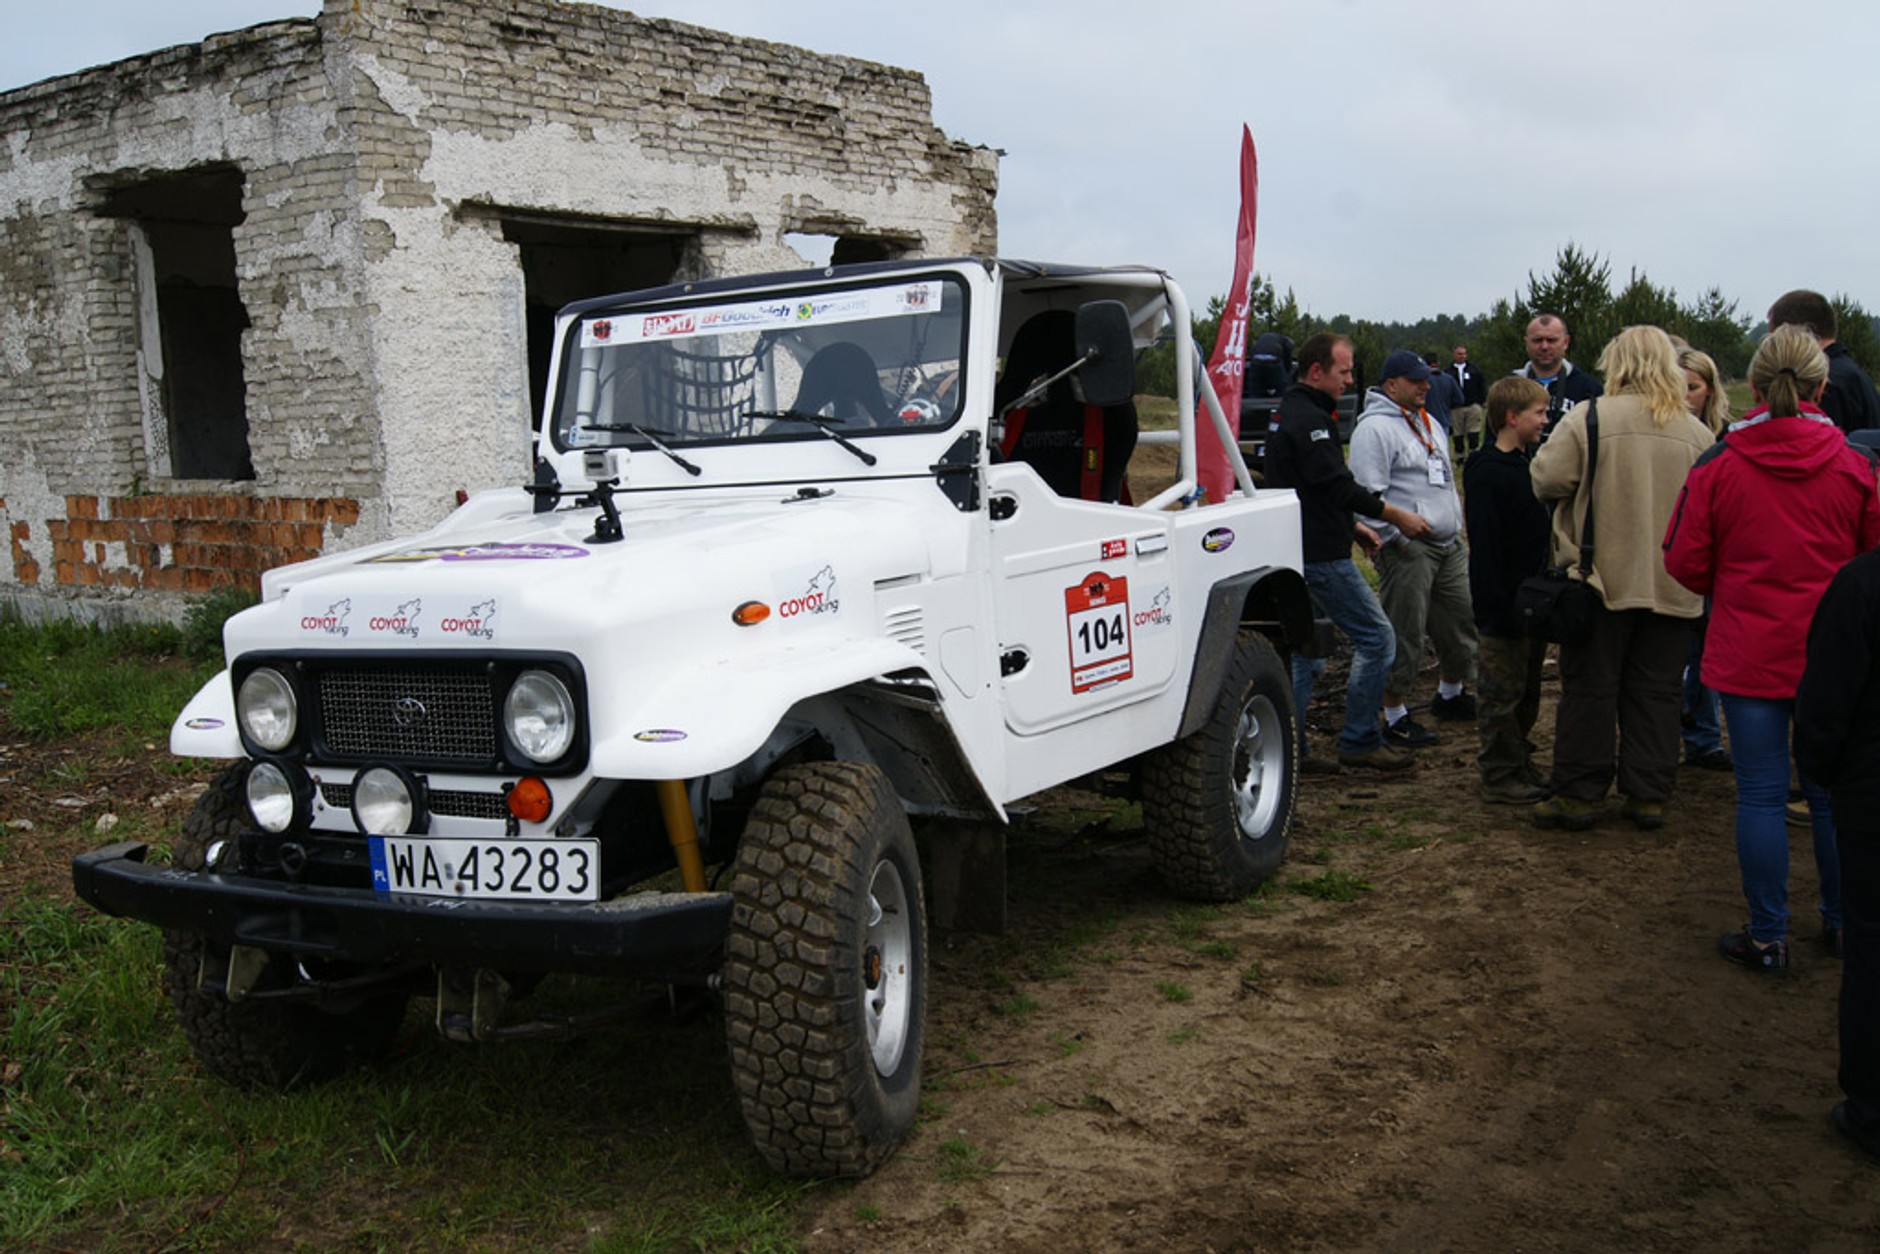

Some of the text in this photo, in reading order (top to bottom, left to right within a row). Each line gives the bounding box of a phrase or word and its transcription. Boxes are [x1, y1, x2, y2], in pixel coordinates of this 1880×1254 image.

[780, 592, 823, 618] COYOT
[301, 616, 338, 630] COYOT
[369, 617, 407, 631] COYOT
[440, 618, 481, 632] COYOT
[1133, 607, 1162, 626] COYOT
[1078, 613, 1125, 655] 104
[391, 843, 443, 890] WA
[457, 845, 590, 895] 43283
